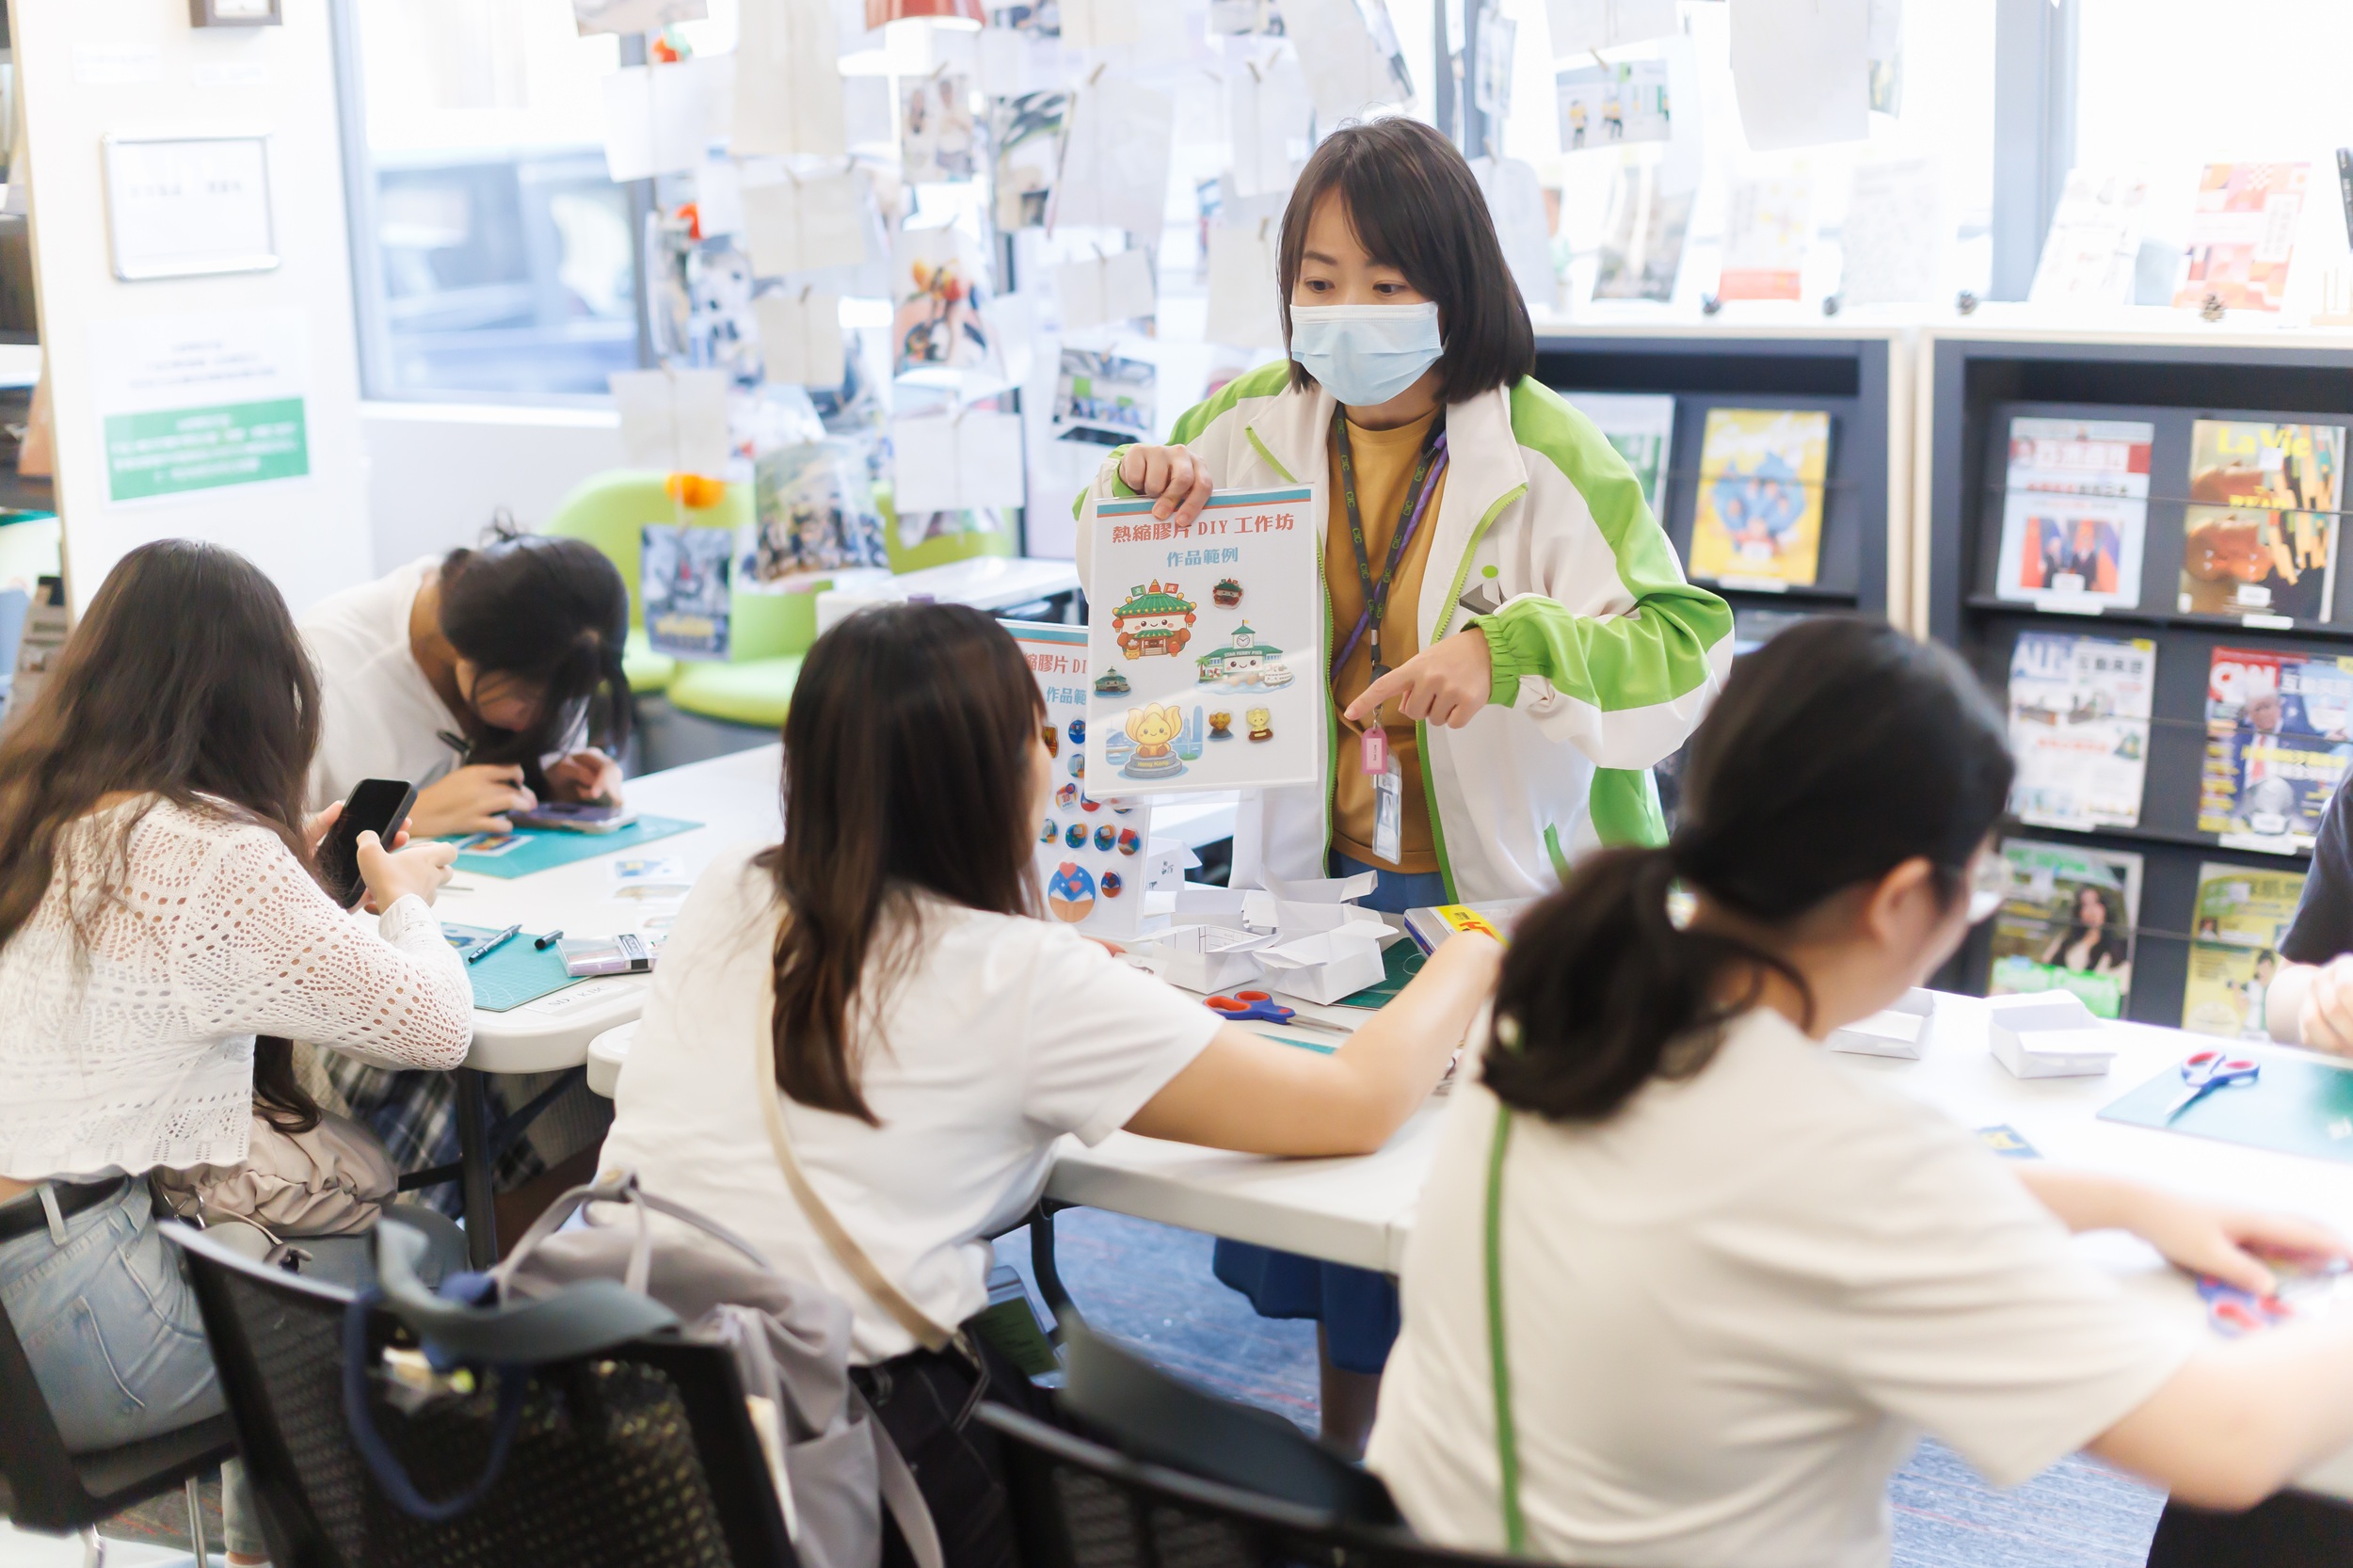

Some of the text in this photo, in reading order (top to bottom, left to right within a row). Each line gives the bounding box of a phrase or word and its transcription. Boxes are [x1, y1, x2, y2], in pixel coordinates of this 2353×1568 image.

[1337, 418, 1345, 434] CIC
[1340, 455, 1350, 471] CIC
[1345, 490, 1355, 508] CIC
[1112, 513, 1295, 543] 熱縮膠片 DIY 工作坊
[1353, 527, 1362, 544] CIC
[1376, 466, 1425, 618] CIC CIC CIC CIC CIC
[1167, 547, 1239, 568] 作品範例
[1360, 563, 1369, 579] CIC
